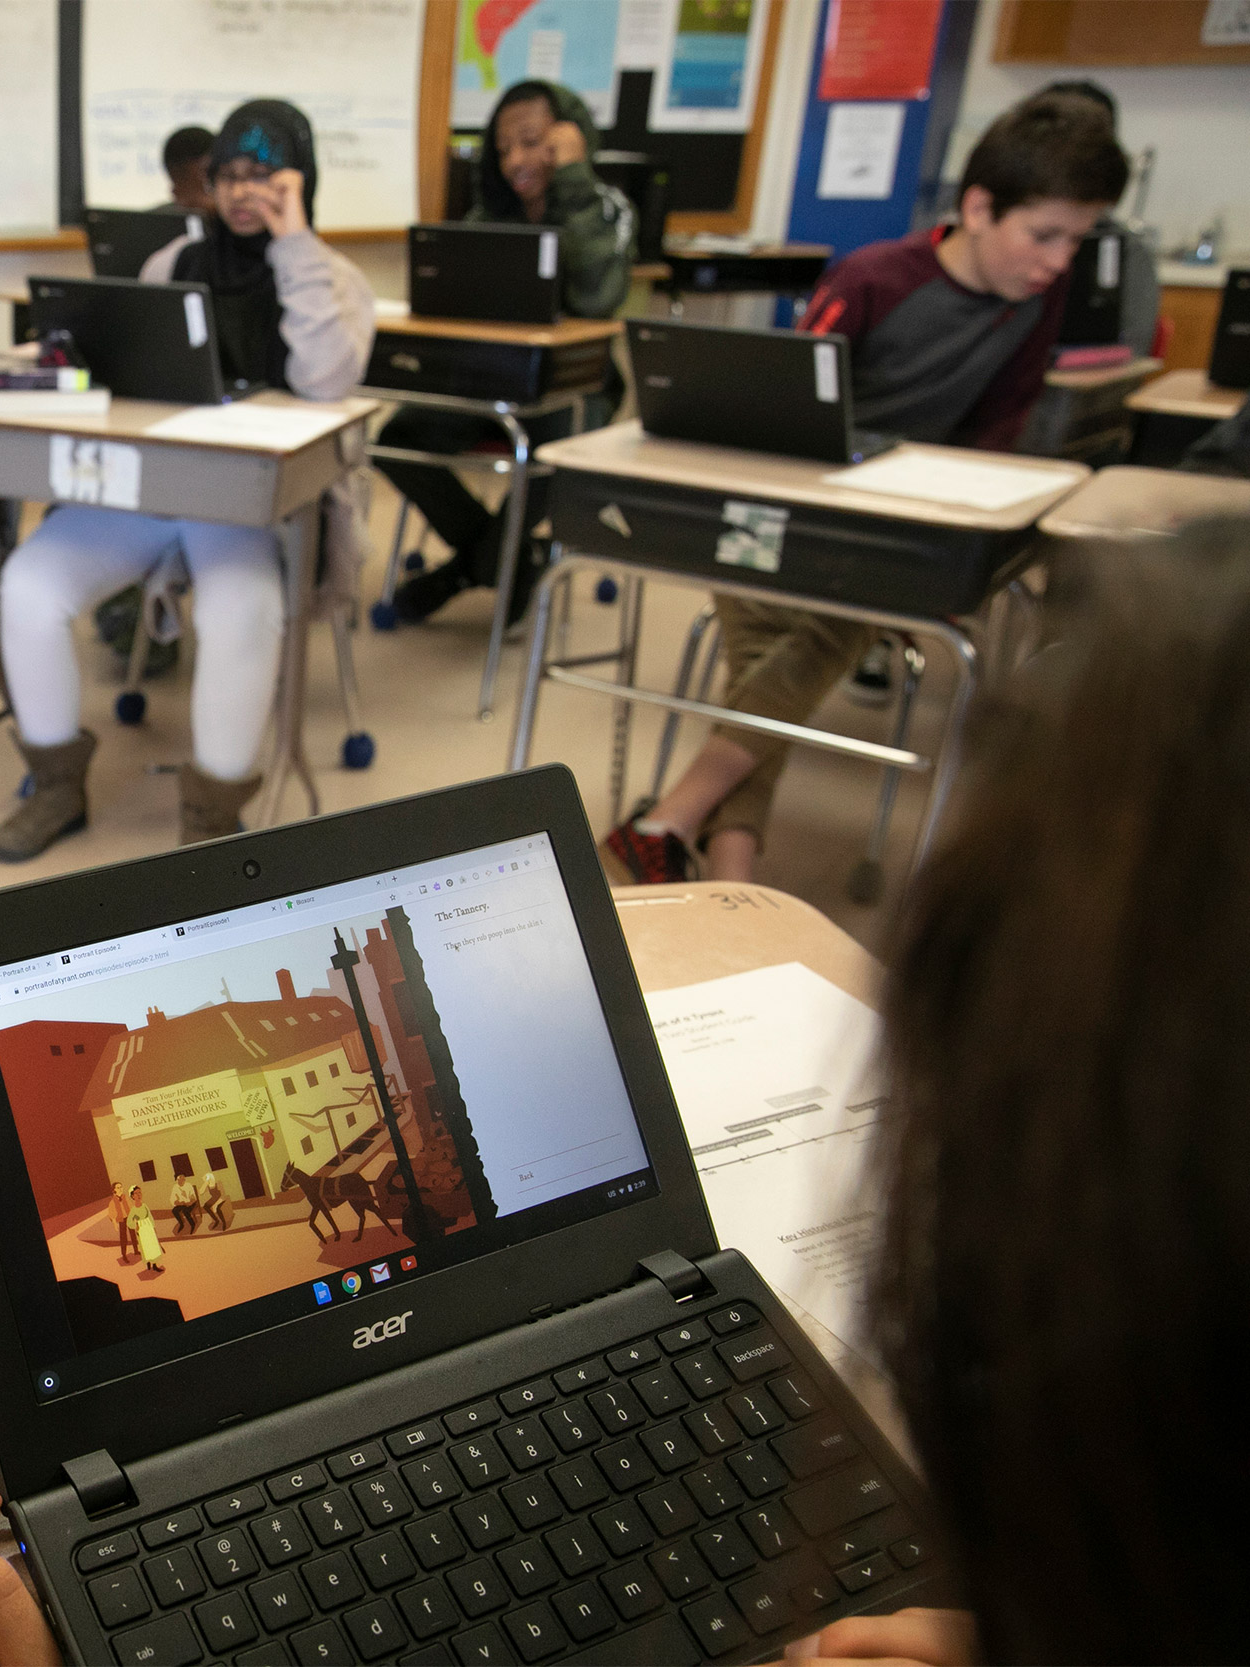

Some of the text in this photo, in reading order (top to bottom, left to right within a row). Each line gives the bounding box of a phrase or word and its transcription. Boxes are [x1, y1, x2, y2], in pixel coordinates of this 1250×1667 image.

[434, 904, 490, 922] The Tannery.
[444, 941, 462, 950] Then
[462, 936, 476, 946] they
[476, 934, 488, 942] rub
[488, 930, 504, 942] poop
[516, 924, 526, 932] the
[72, 951, 94, 961] Portrait
[94, 946, 116, 958] Episode
[2, 967, 22, 978] Portrait
[24, 951, 170, 994] portraitofatyrant.com/episodes/episode-2.html
[160, 1091, 176, 1100] Your
[196, 1084, 205, 1092] AT
[174, 1088, 220, 1108] TANNERY
[133, 1100, 228, 1128] AND LEATHERWORKS
[518, 1171, 534, 1182] Back
[634, 1180, 646, 1190] 2:39
[608, 1190, 616, 1198] US
[352, 1310, 413, 1350] acer
[734, 1344, 774, 1363] backspace
[618, 1410, 627, 1420] 0
[573, 1427, 582, 1438] 9
[821, 1434, 842, 1447] enter
[527, 1445, 537, 1456] 8
[664, 1441, 674, 1453] p
[479, 1463, 488, 1474] 7
[620, 1459, 629, 1468] o
[433, 1481, 442, 1493] 6
[574, 1476, 582, 1487] i
[861, 1480, 880, 1493] shift
[383, 1500, 393, 1512] 5
[527, 1496, 538, 1506] u
[335, 1519, 343, 1530] 4
[479, 1515, 488, 1529] y
[616, 1521, 628, 1533] k
[281, 1539, 291, 1551] 3
[431, 1534, 440, 1544] t
[99, 1545, 115, 1556] esc
[572, 1539, 582, 1555] j
[381, 1554, 387, 1564] r
[228, 1559, 239, 1572] 2
[521, 1560, 534, 1572] h
[176, 1579, 184, 1590] 1
[329, 1575, 338, 1584] e
[474, 1581, 486, 1596] g
[625, 1583, 641, 1596] m
[273, 1594, 286, 1606] w
[424, 1599, 431, 1613] f
[757, 1596, 772, 1609] ctrl
[579, 1604, 591, 1616] n
[222, 1616, 234, 1629] q
[372, 1619, 382, 1634] d
[711, 1619, 724, 1630] alt
[527, 1624, 540, 1636] b
[136, 1647, 154, 1660] tab
[318, 1645, 328, 1656] s
[479, 1646, 489, 1657] v
